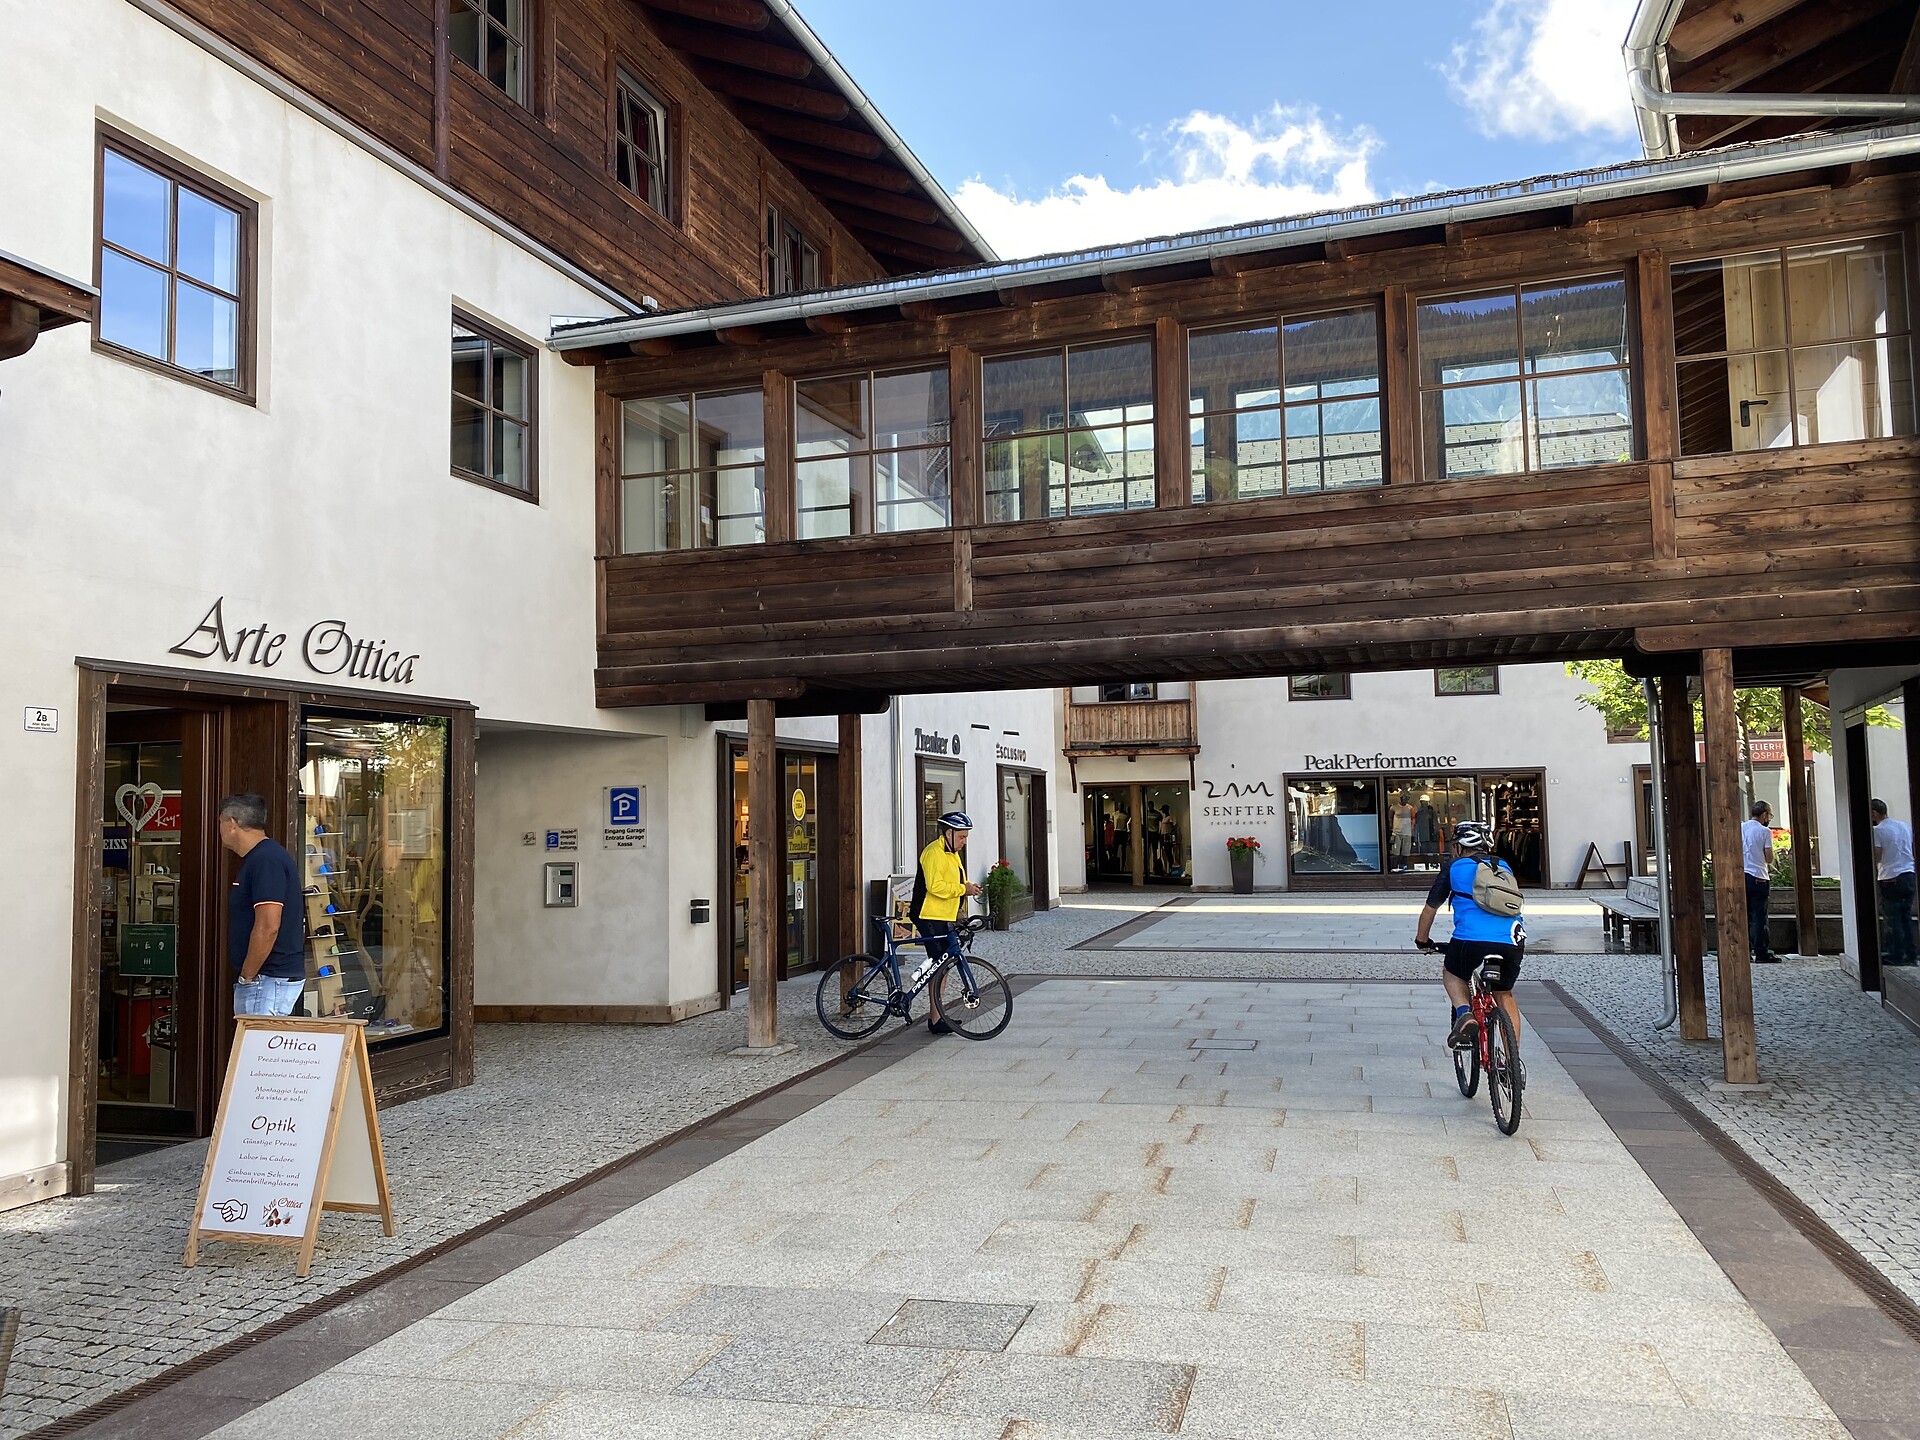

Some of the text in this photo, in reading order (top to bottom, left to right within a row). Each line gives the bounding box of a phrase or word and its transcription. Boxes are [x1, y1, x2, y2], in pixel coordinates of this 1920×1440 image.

[168, 595, 420, 684] Arte Ottica
[914, 727, 948, 754] Trenker
[1203, 805, 1275, 817] SENFTER
[604, 828, 626, 836] Eingang
[103, 838, 128, 850] EISS
[268, 1035, 317, 1051] Ottica
[257, 1055, 321, 1066] Prezzi vantaggiosi
[250, 1070, 287, 1078] Laboratorio
[296, 1072, 321, 1080] Cadore
[254, 1086, 308, 1095] Montaggio lenti
[251, 1115, 296, 1136] Optik
[242, 1137, 297, 1147] Günstige Preise
[225, 1176, 299, 1187] Sonnenbrillengläsern
